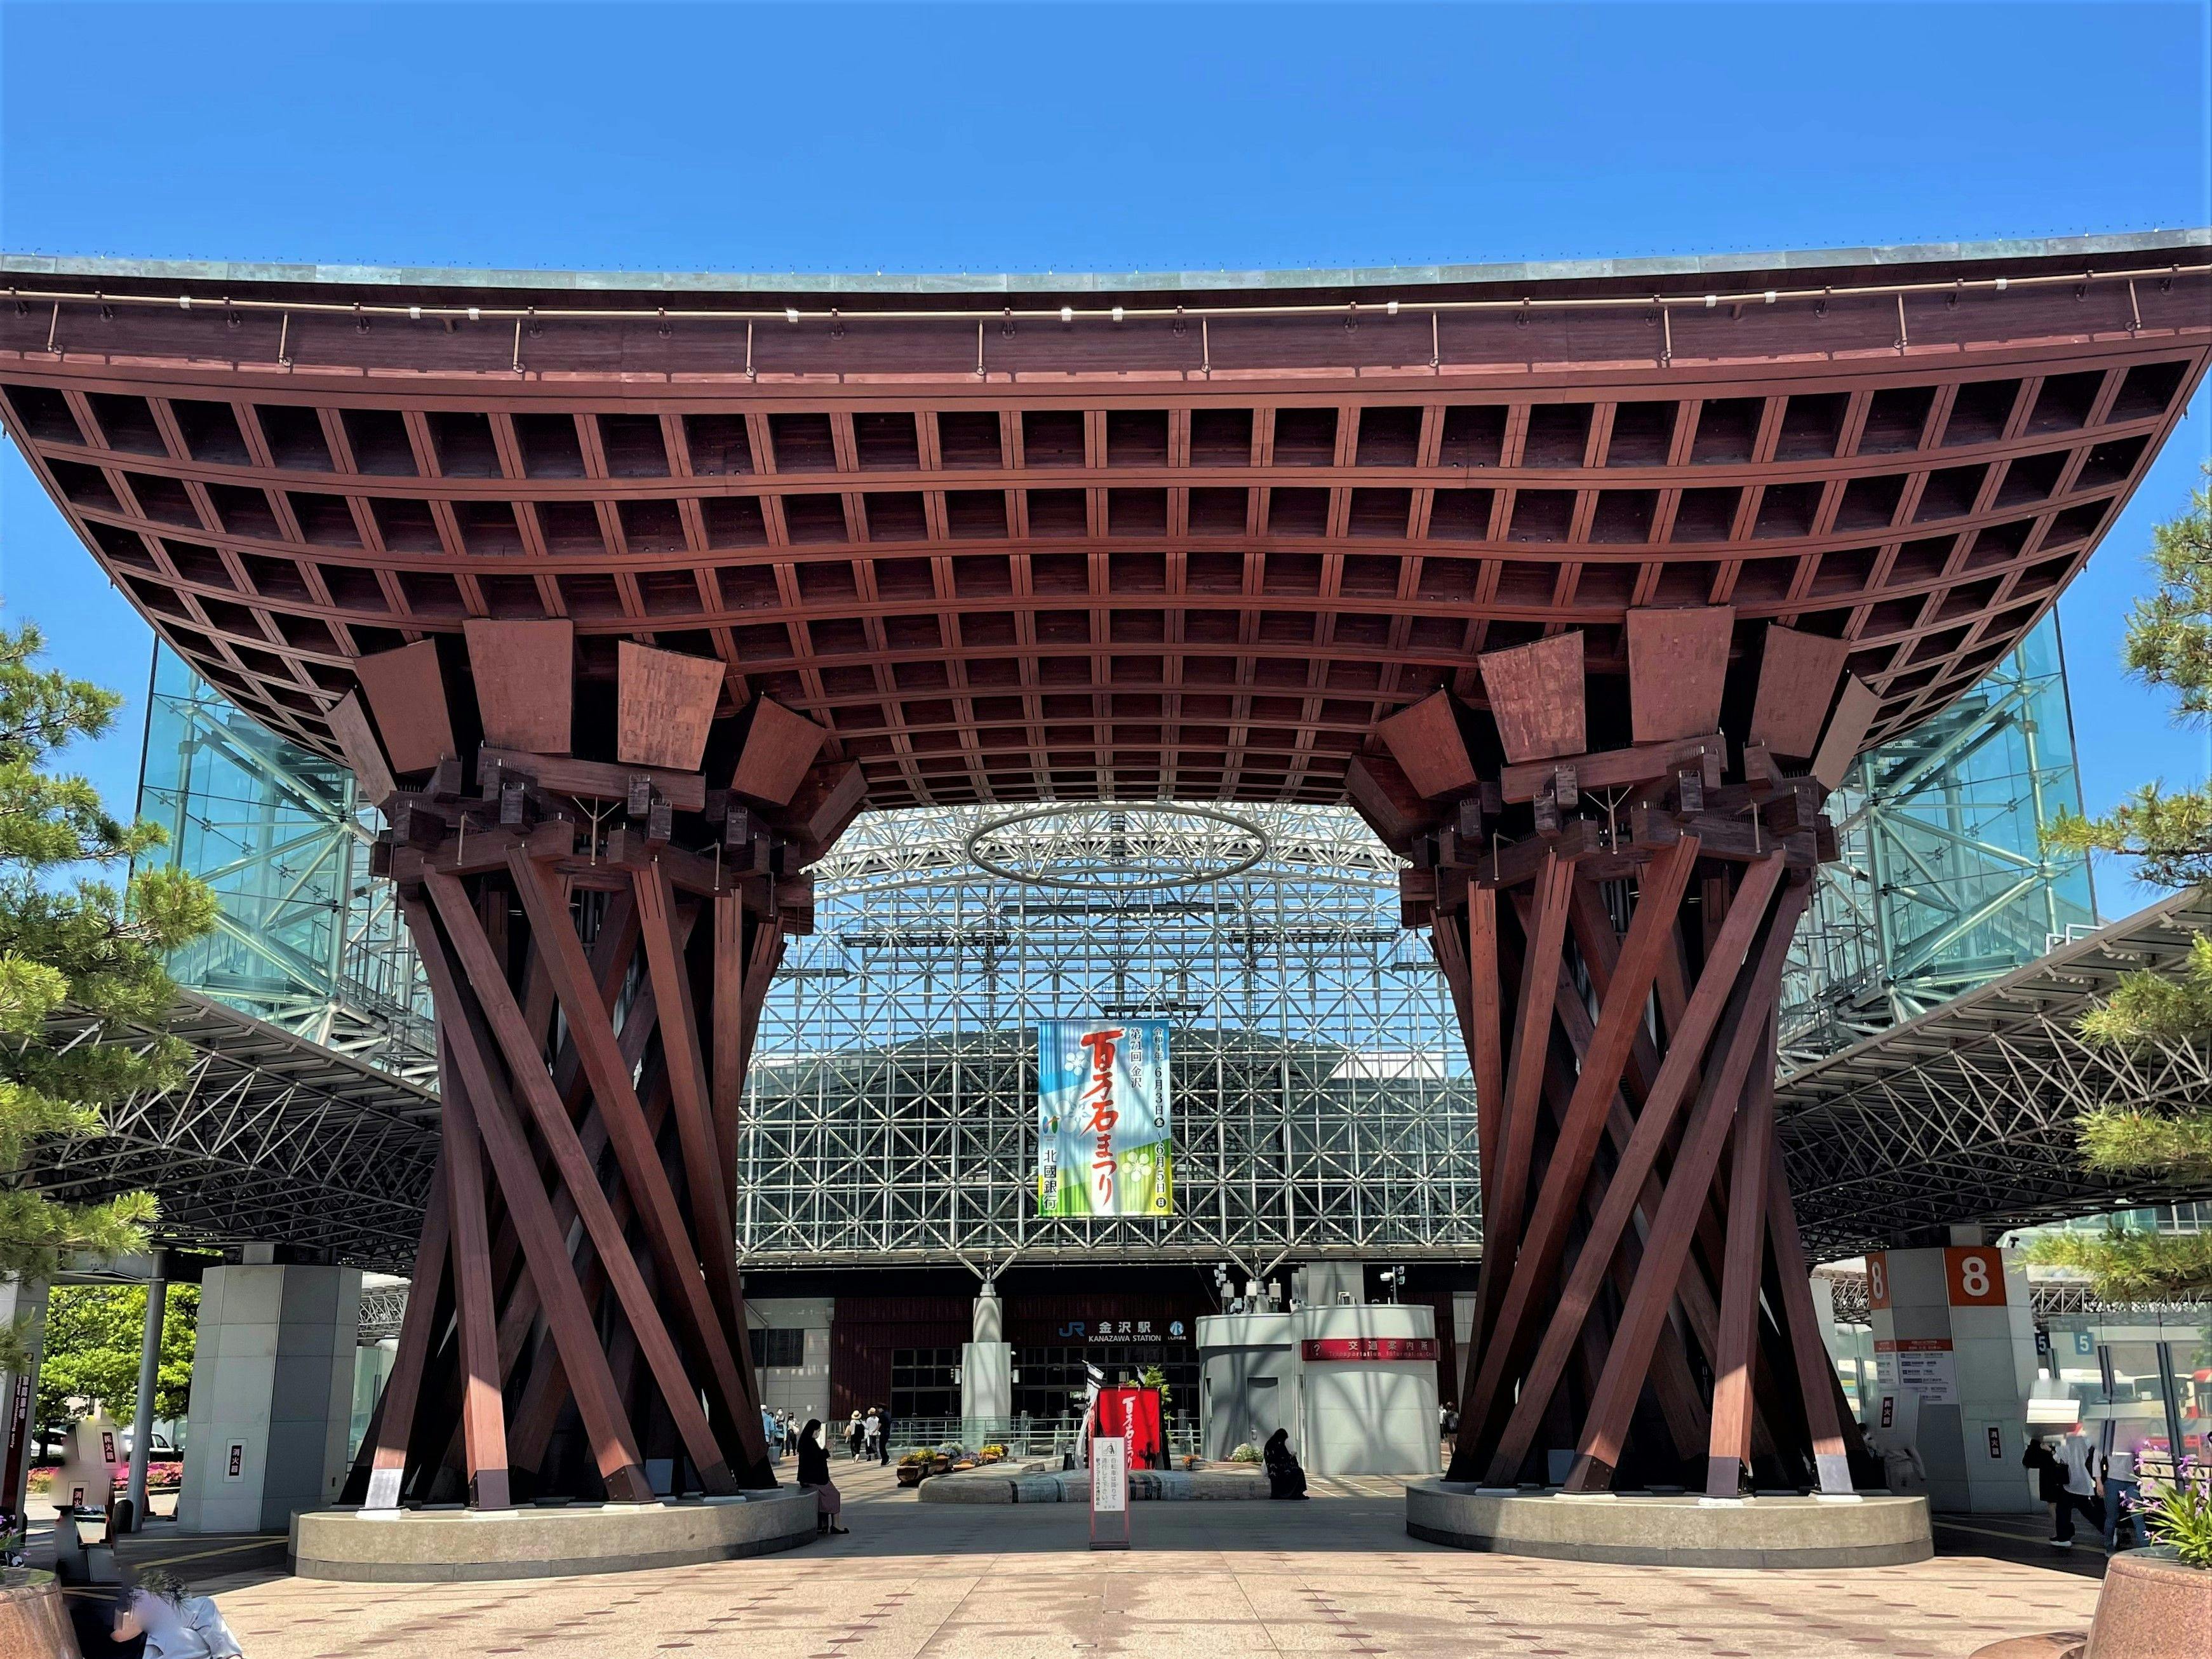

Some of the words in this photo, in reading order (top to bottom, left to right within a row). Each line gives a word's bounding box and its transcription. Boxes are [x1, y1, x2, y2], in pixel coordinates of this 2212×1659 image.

[1079, 1028, 1125, 1207] 百万石まつり
[1043, 1149, 1057, 1209] 北國銀行
[1872, 1261, 1884, 1300] 8
[1962, 1256, 1990, 1296] 8
[1059, 1322, 1085, 1337] JR
[1099, 1321, 1151, 1333] 金沢駅
[1348, 1341, 1428, 1351] 交通案内所
[2039, 1336, 2048, 1353] 5
[2079, 1335, 2089, 1353] 5
